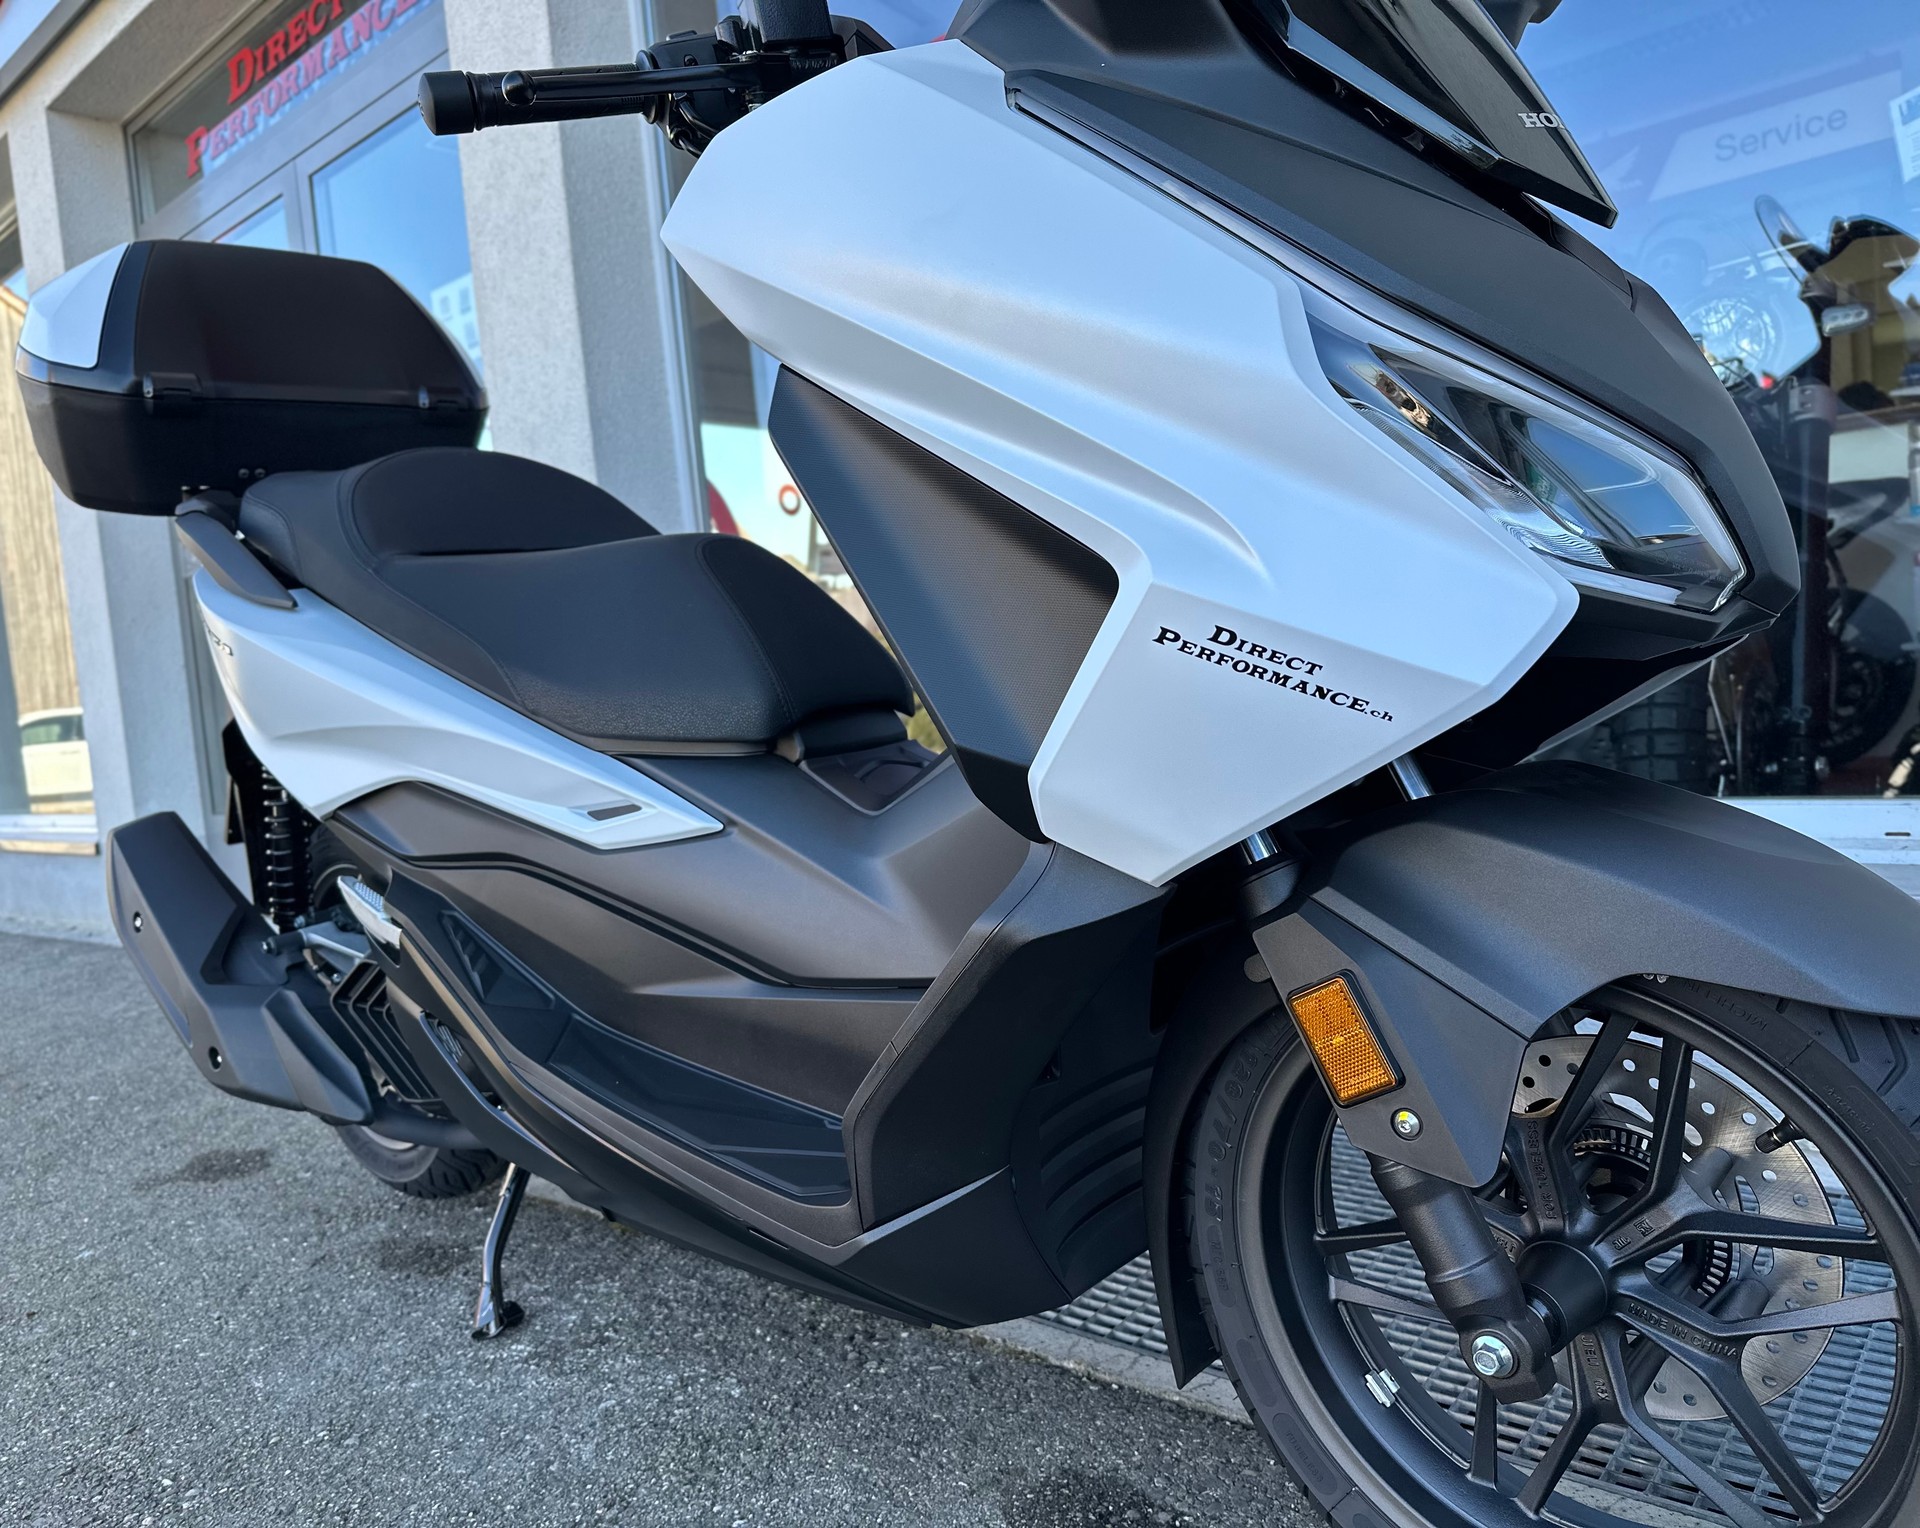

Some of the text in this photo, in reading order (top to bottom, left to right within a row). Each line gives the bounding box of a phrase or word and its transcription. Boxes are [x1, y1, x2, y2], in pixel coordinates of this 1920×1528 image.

[1517, 112, 1565, 129] HO
[1714, 108, 1848, 162] Service
[1153, 626, 1394, 723] PERFORMANCE.ch
[1207, 624, 1323, 676] DIRECT
[1526, 1120, 1547, 1190] TUBELESS
[1627, 1303, 1738, 1357] MADE IN CHINA
